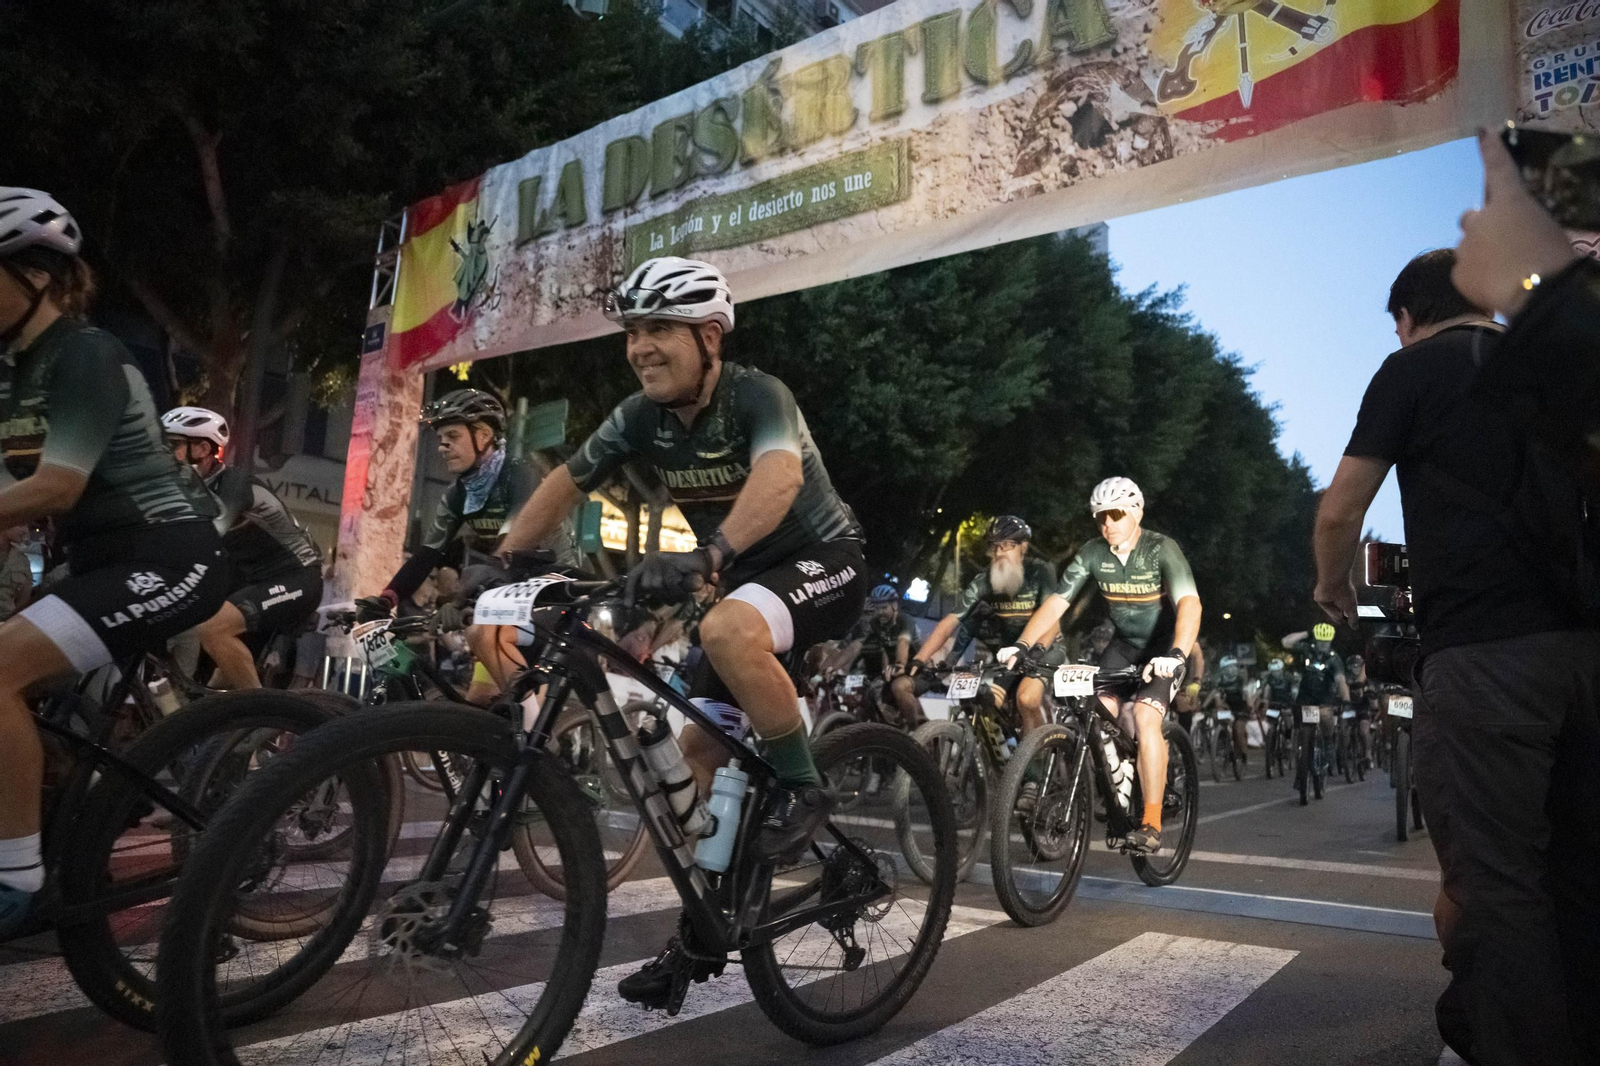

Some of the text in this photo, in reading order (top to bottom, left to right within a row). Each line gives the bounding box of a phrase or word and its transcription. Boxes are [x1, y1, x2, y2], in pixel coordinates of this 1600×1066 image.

[515, 158, 587, 250] LA
[649, 232, 664, 251] La
[711, 213, 722, 234] y
[729, 205, 742, 226] el
[748, 191, 803, 222] desierto
[811, 180, 836, 203] nos
[844, 171, 872, 193] une
[101, 563, 209, 628] LA PURÍSIMA
[789, 565, 857, 604] LA PURÍSIMA
[955, 678, 979, 690] 5215
[1061, 670, 1092, 683] 6242
